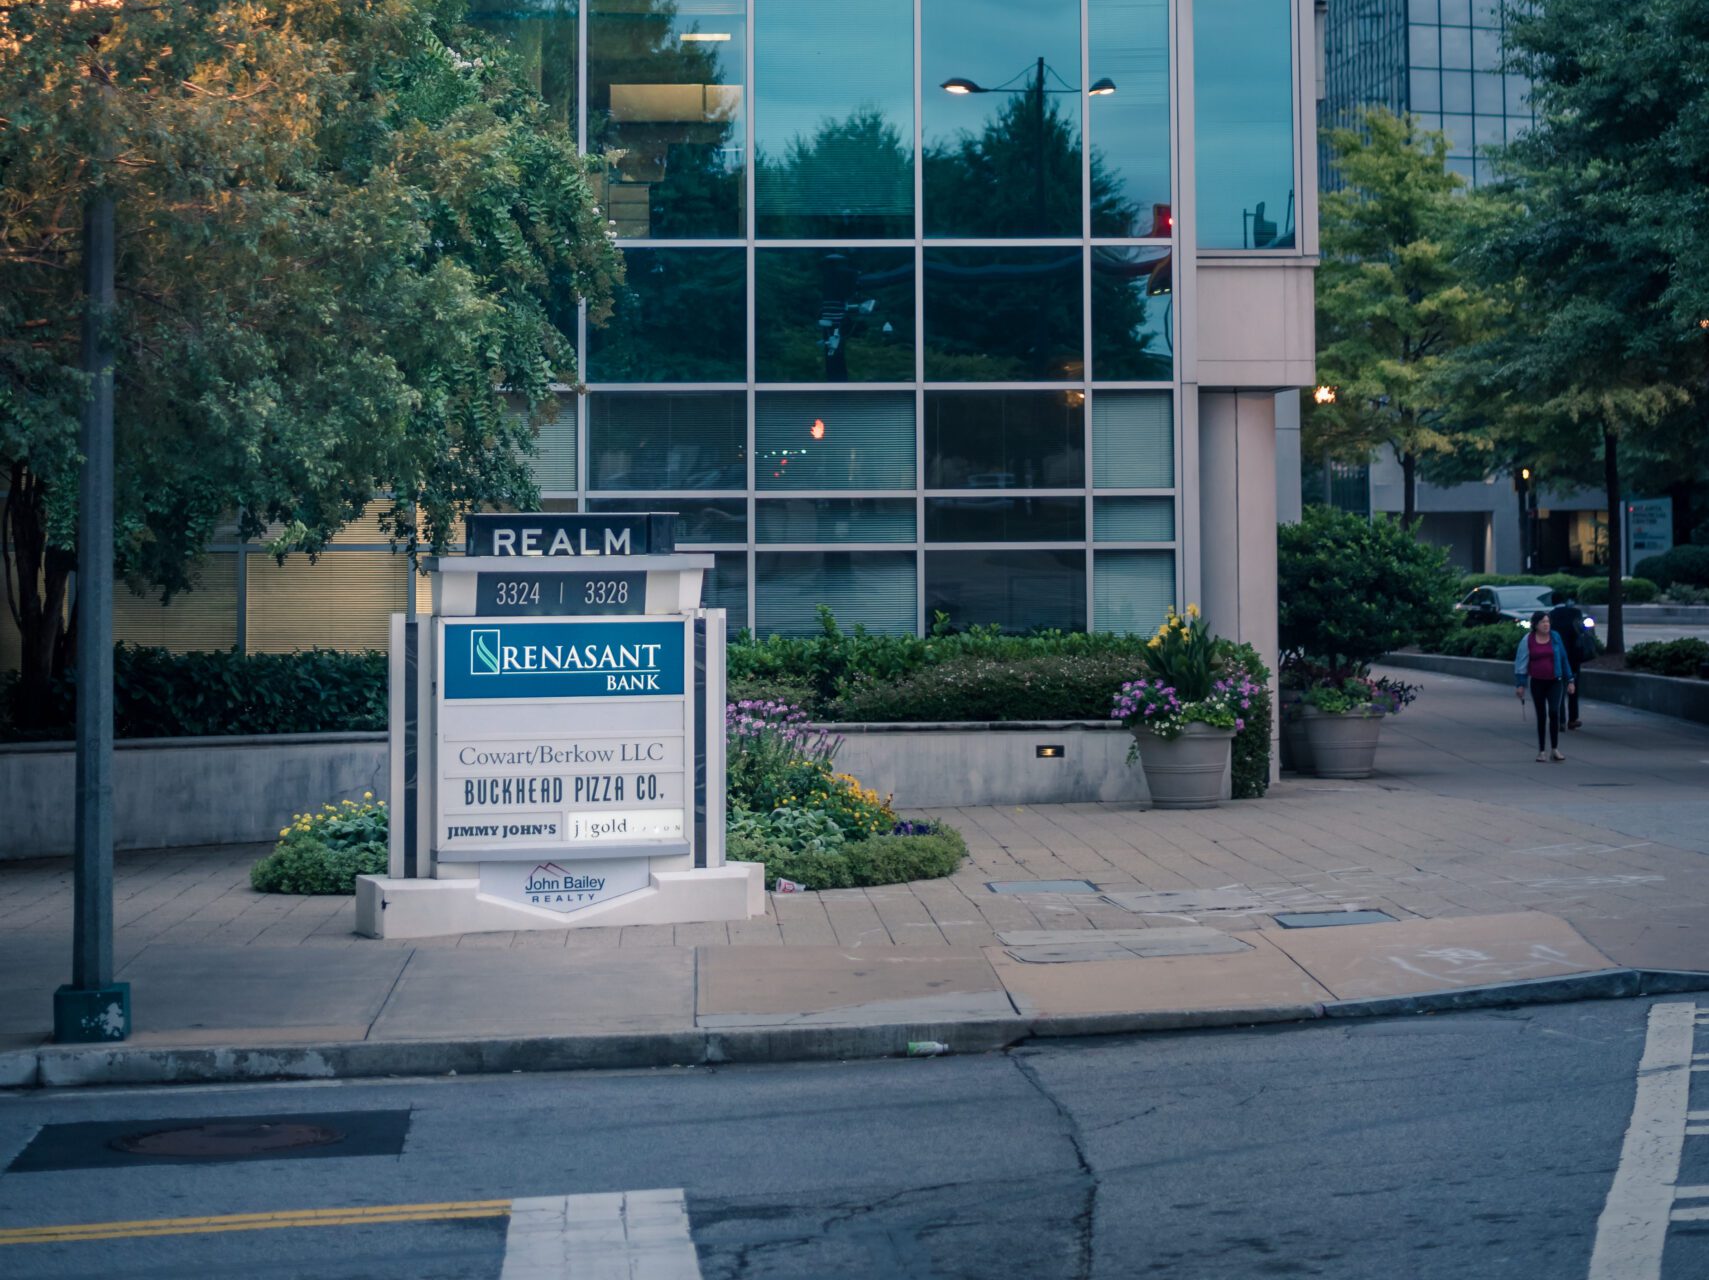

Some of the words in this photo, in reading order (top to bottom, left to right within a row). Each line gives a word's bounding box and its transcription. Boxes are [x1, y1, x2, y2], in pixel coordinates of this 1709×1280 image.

[493, 527, 631, 557] REALM
[496, 581, 541, 606] 3324
[584, 580, 629, 605] 3328
[501, 644, 662, 670] RENASANT
[606, 674, 661, 692] BANK
[459, 744, 615, 766] Cowart/Berkow
[620, 742, 664, 762] LLC
[464, 776, 563, 806] BUCKHEAD
[574, 775, 624, 803] PIZZA
[636, 773, 665, 801] CO.
[447, 824, 500, 840] JIMMY
[502, 823, 557, 839] JOHN'S
[525, 875, 560, 891] John
[563, 875, 605, 891] Bailey
[532, 893, 595, 903] REALTY
